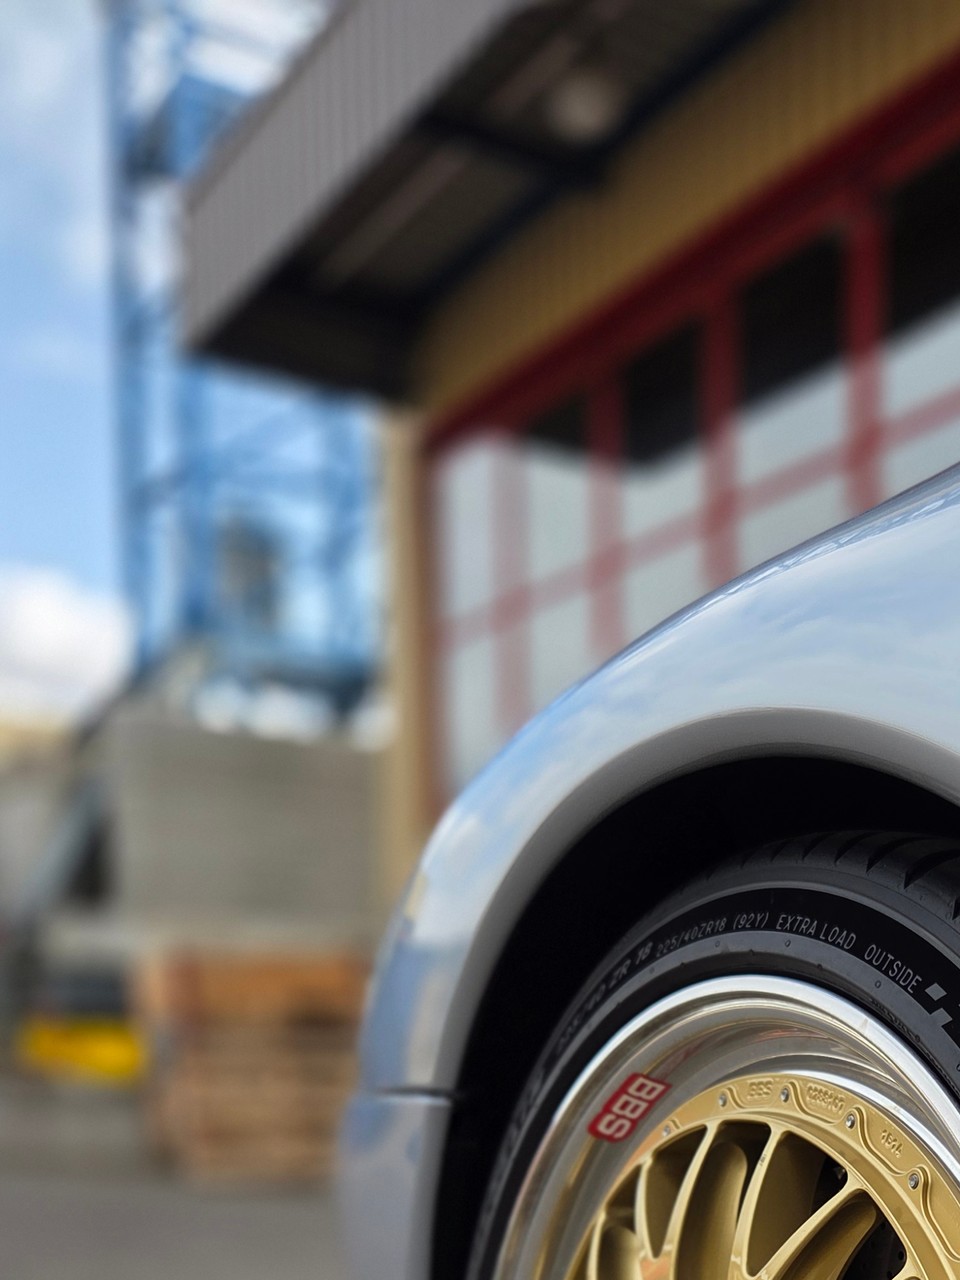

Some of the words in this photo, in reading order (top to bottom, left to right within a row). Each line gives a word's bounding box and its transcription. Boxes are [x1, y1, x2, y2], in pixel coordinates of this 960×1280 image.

[732, 911, 769, 930] (92Y)
[776, 914, 818, 936] EXTRA
[819, 923, 857, 951] LOAD
[864, 944, 922, 994] OUTSIDE
[597, 1076, 667, 1139] BBS
